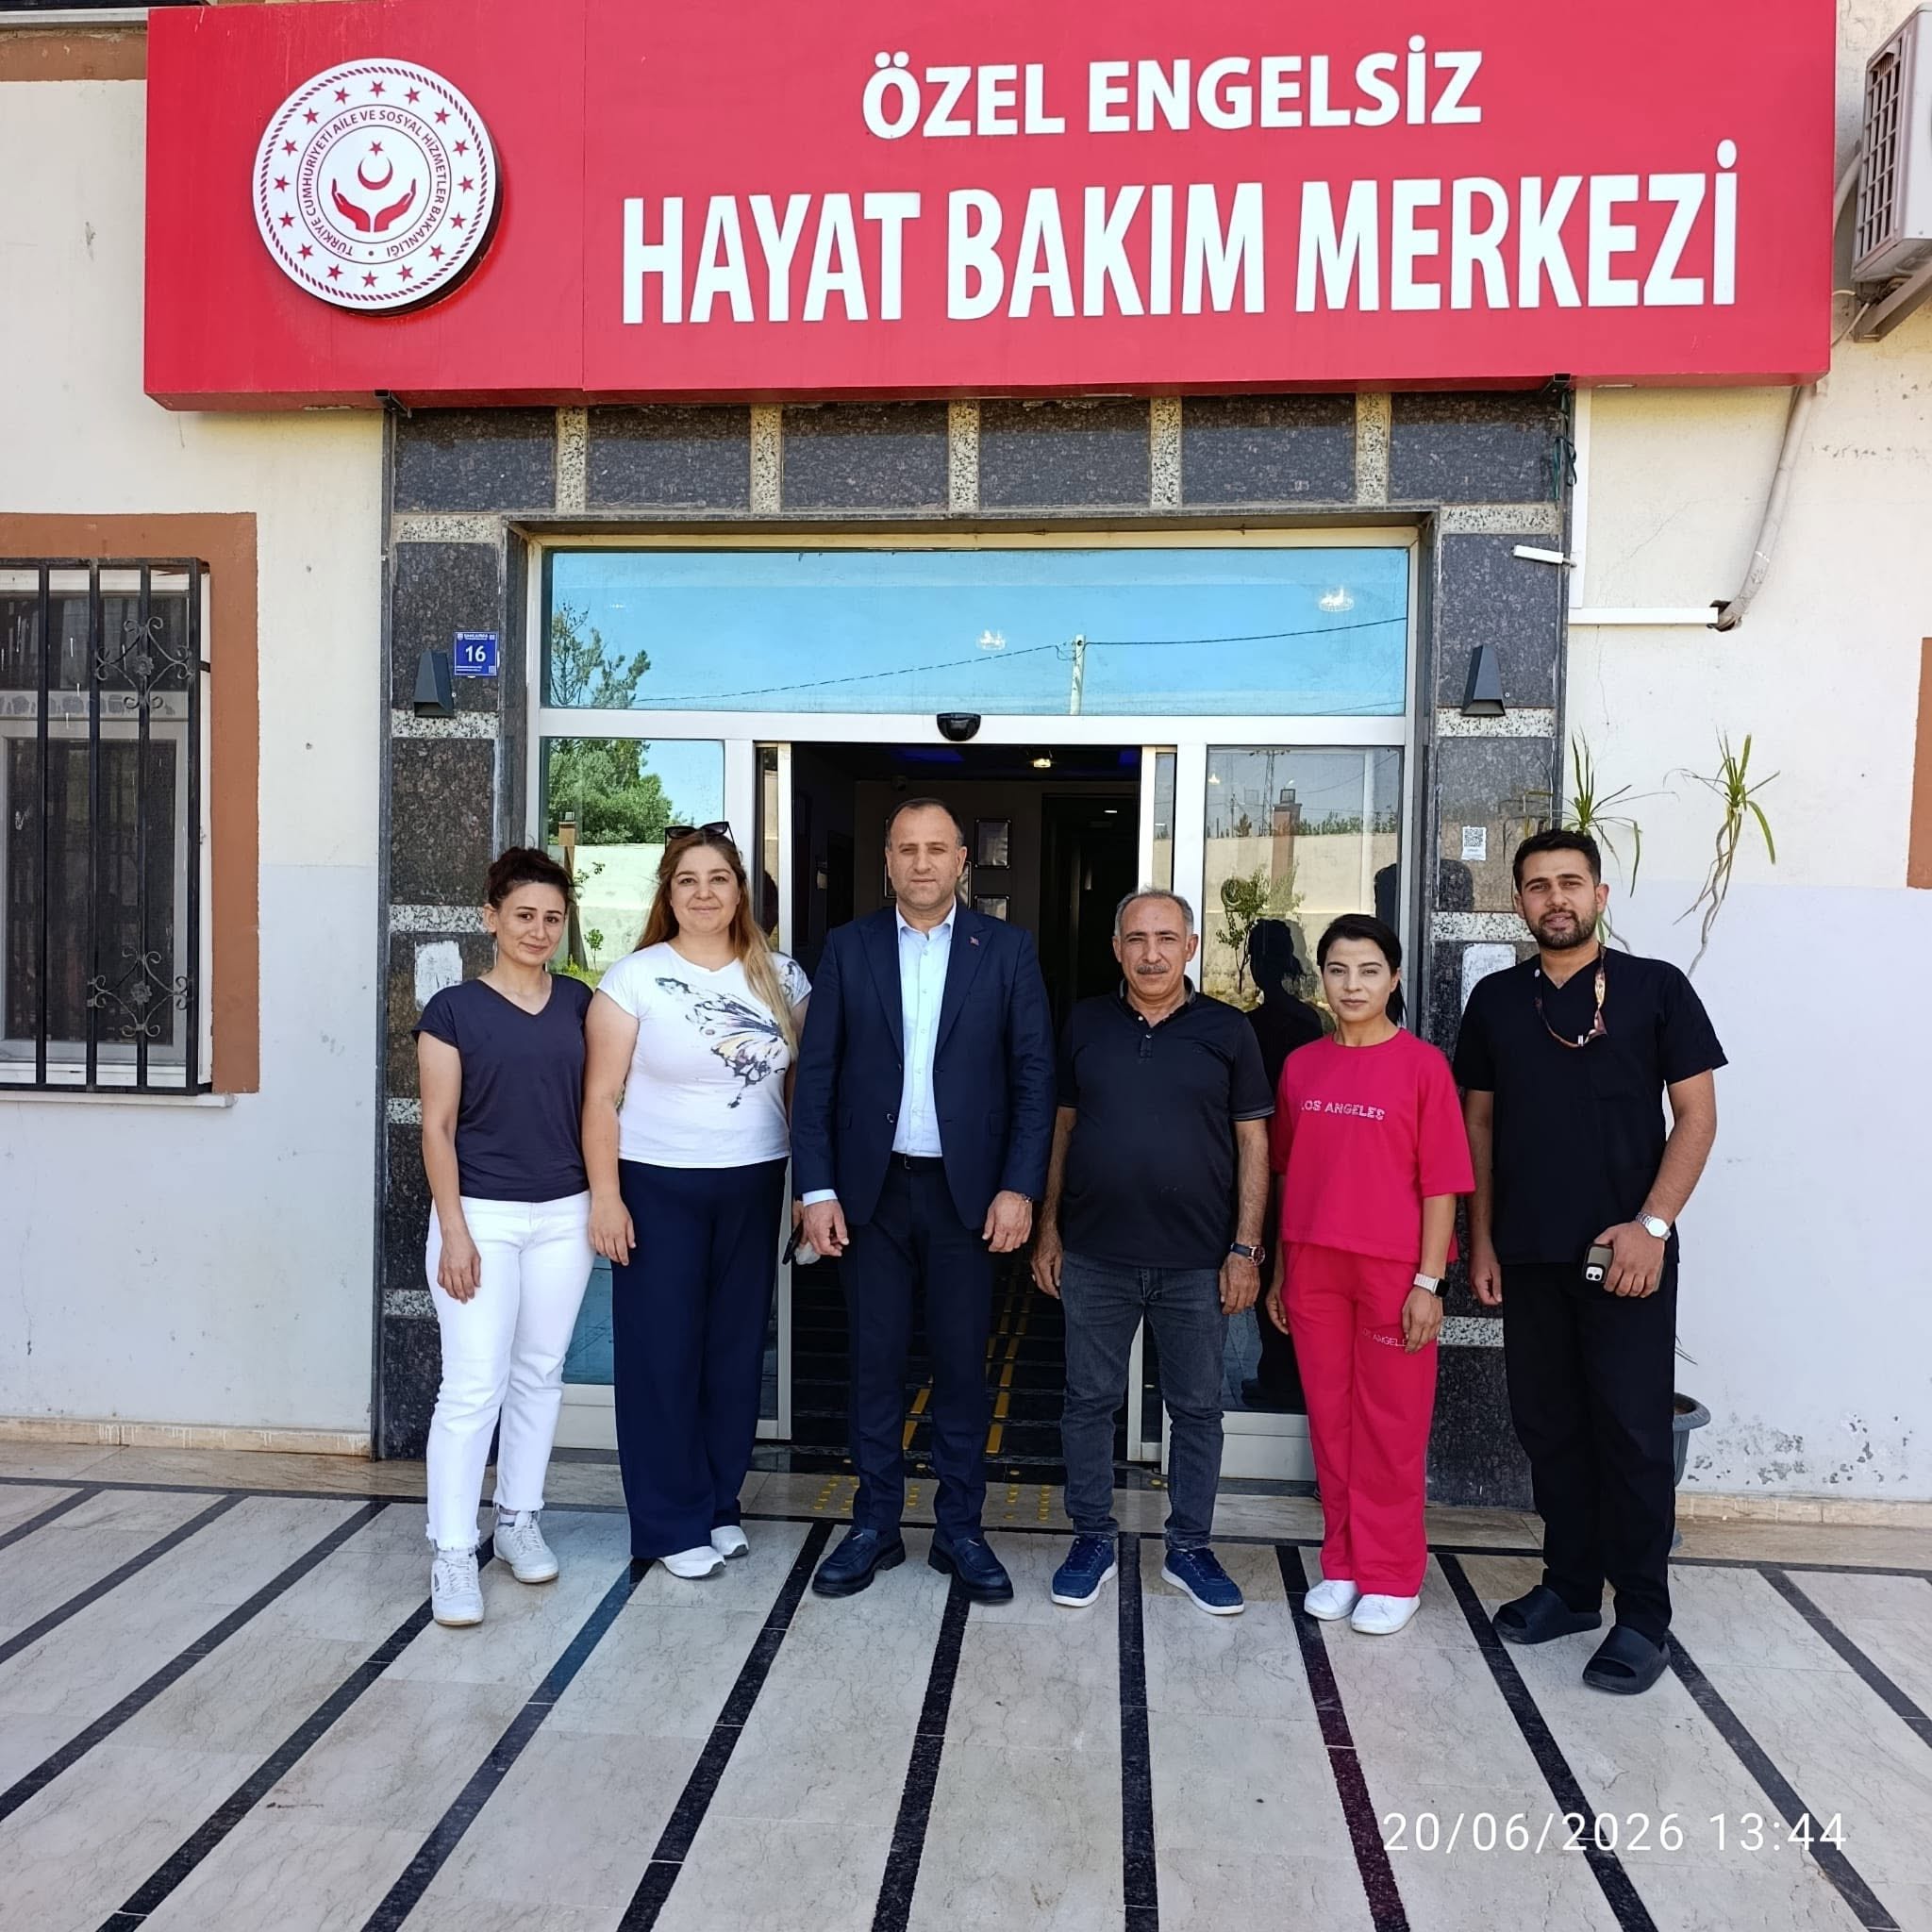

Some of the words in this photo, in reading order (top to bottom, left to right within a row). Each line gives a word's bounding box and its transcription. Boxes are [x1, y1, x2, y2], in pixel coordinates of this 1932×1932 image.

[862, 50, 1066, 141] ÖZEL
[1088, 34, 1483, 133] ENGELSİZ
[332, 112, 358, 135] AİLE
[358, 109, 376, 122] VE
[378, 109, 422, 137] SOSYAL
[302, 129, 333, 217] CUMHURİYETİ
[421, 133, 447, 204] HİZMETLER
[310, 217, 354, 257] TÜRKİYE
[386, 206, 441, 258] BAKANLIĞI
[622, 191, 922, 325] HAYAT
[946, 181, 1265, 321] BAKIM
[1294, 139, 1738, 313] MERKEZİ
[465, 645, 487, 662] 16
[1324, 1102, 1386, 1121] ANGELES
